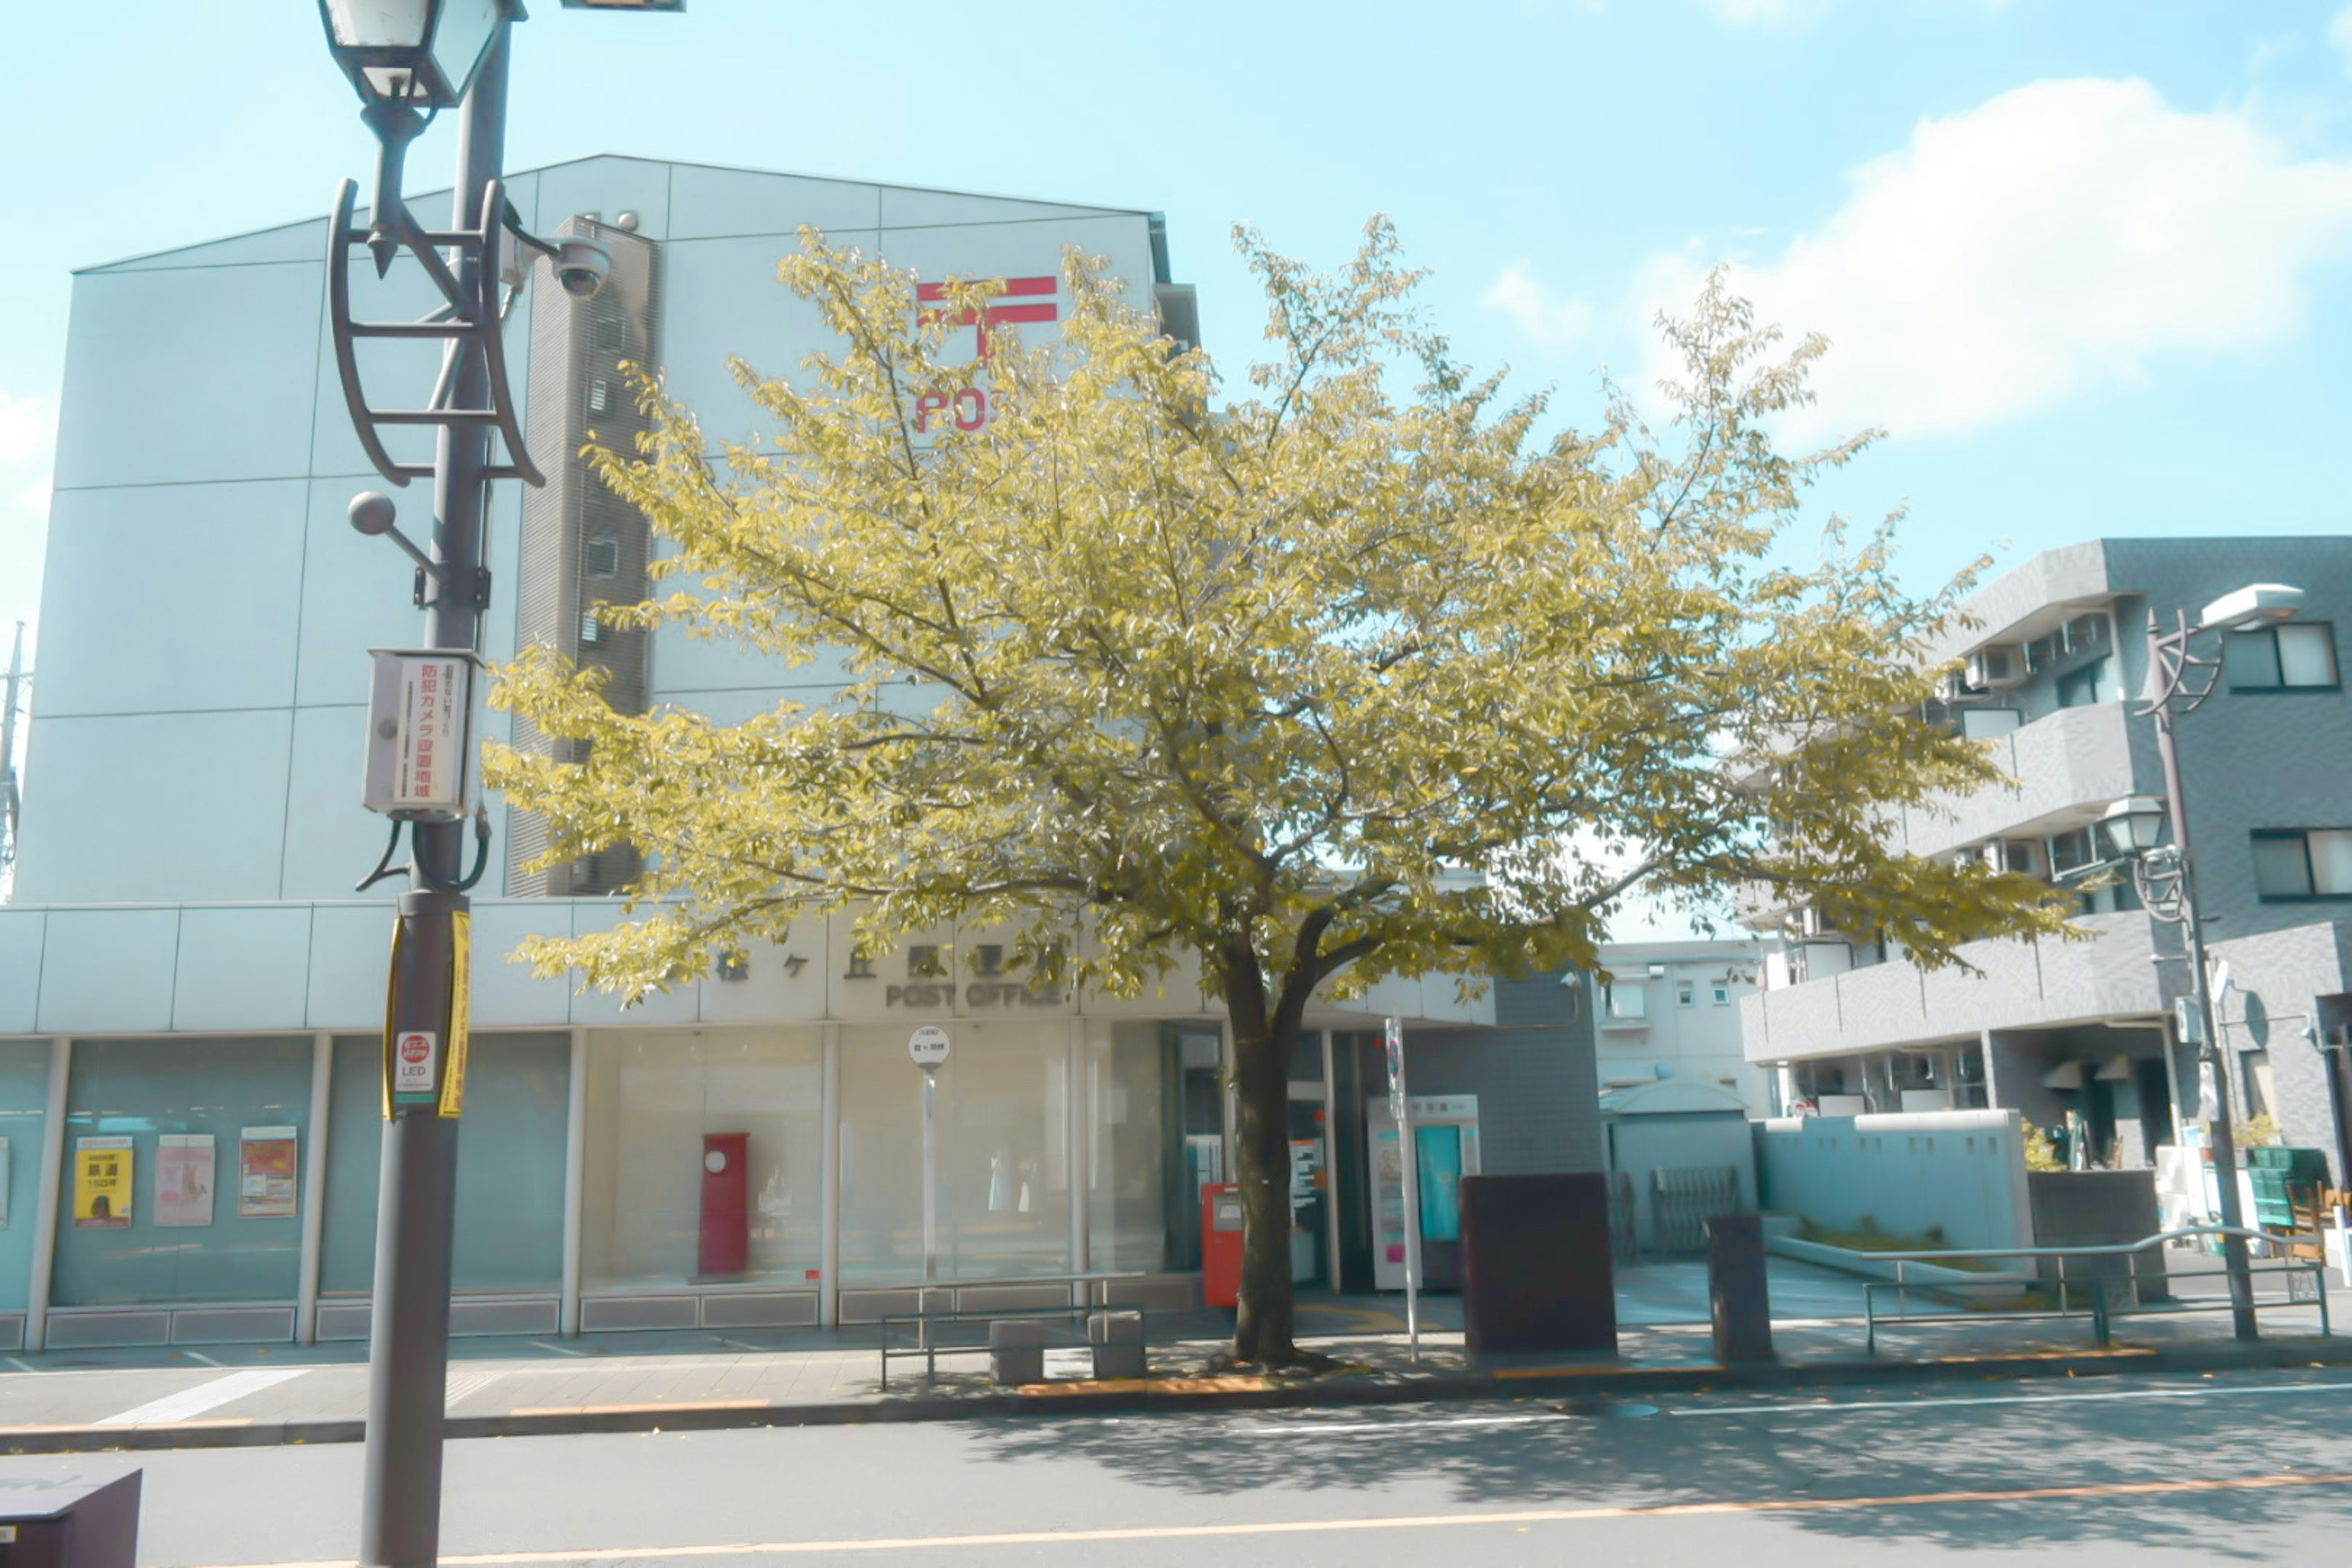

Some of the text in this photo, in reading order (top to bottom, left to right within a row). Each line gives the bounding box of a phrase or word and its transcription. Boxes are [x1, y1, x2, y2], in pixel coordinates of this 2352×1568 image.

[414, 664, 438, 797] 防犯カメラ設置地域
[886, 982, 1062, 1008] POST OFFICE
[402, 1066, 426, 1076] LED
